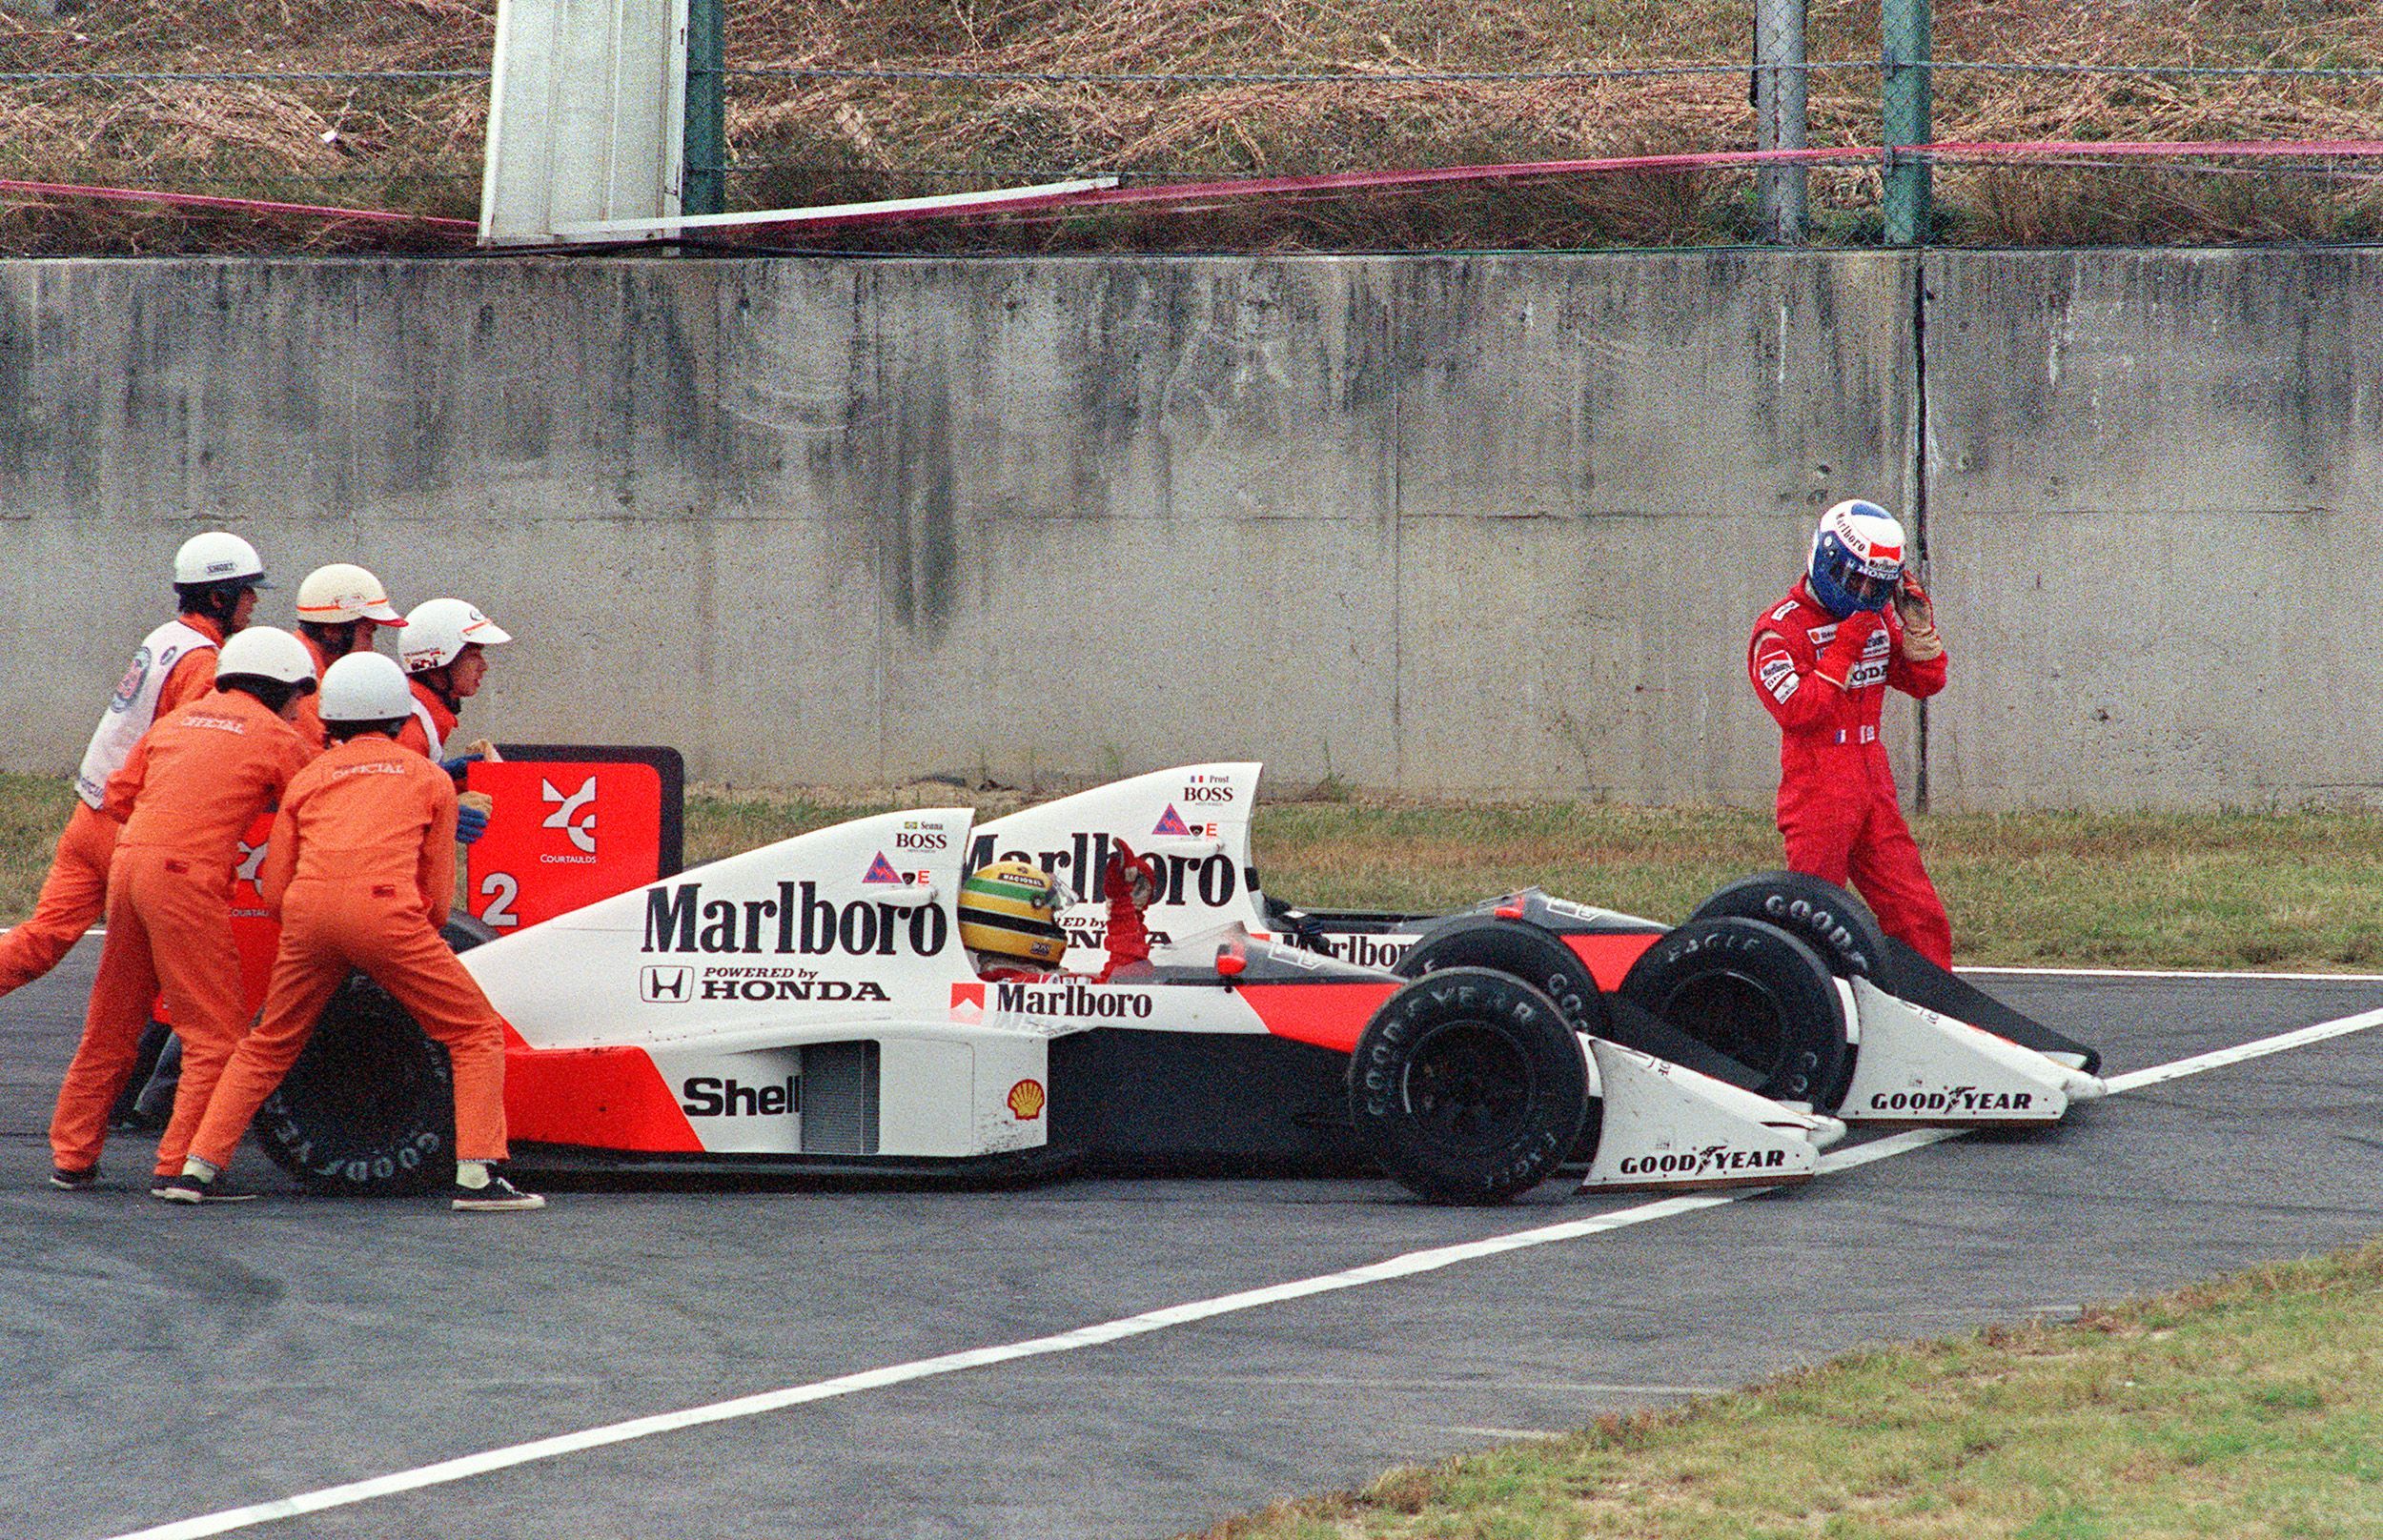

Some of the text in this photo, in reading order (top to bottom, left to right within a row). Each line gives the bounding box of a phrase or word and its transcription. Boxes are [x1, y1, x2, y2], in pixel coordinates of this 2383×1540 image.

[1836, 512, 1866, 552] Marlboro
[1210, 775, 1230, 783] Prost
[1184, 787, 1233, 801] BOSS
[920, 821, 944, 830] Senna
[896, 833, 947, 849] BOSS
[1003, 873, 1043, 886] NACIONAL
[481, 871, 519, 926] 2
[640, 881, 947, 957] Marlboro
[704, 967, 819, 981] POWERED by
[701, 980, 891, 1001] HONDA
[997, 983, 1153, 1018] Marlboro
[682, 1075, 800, 1117] Shell
